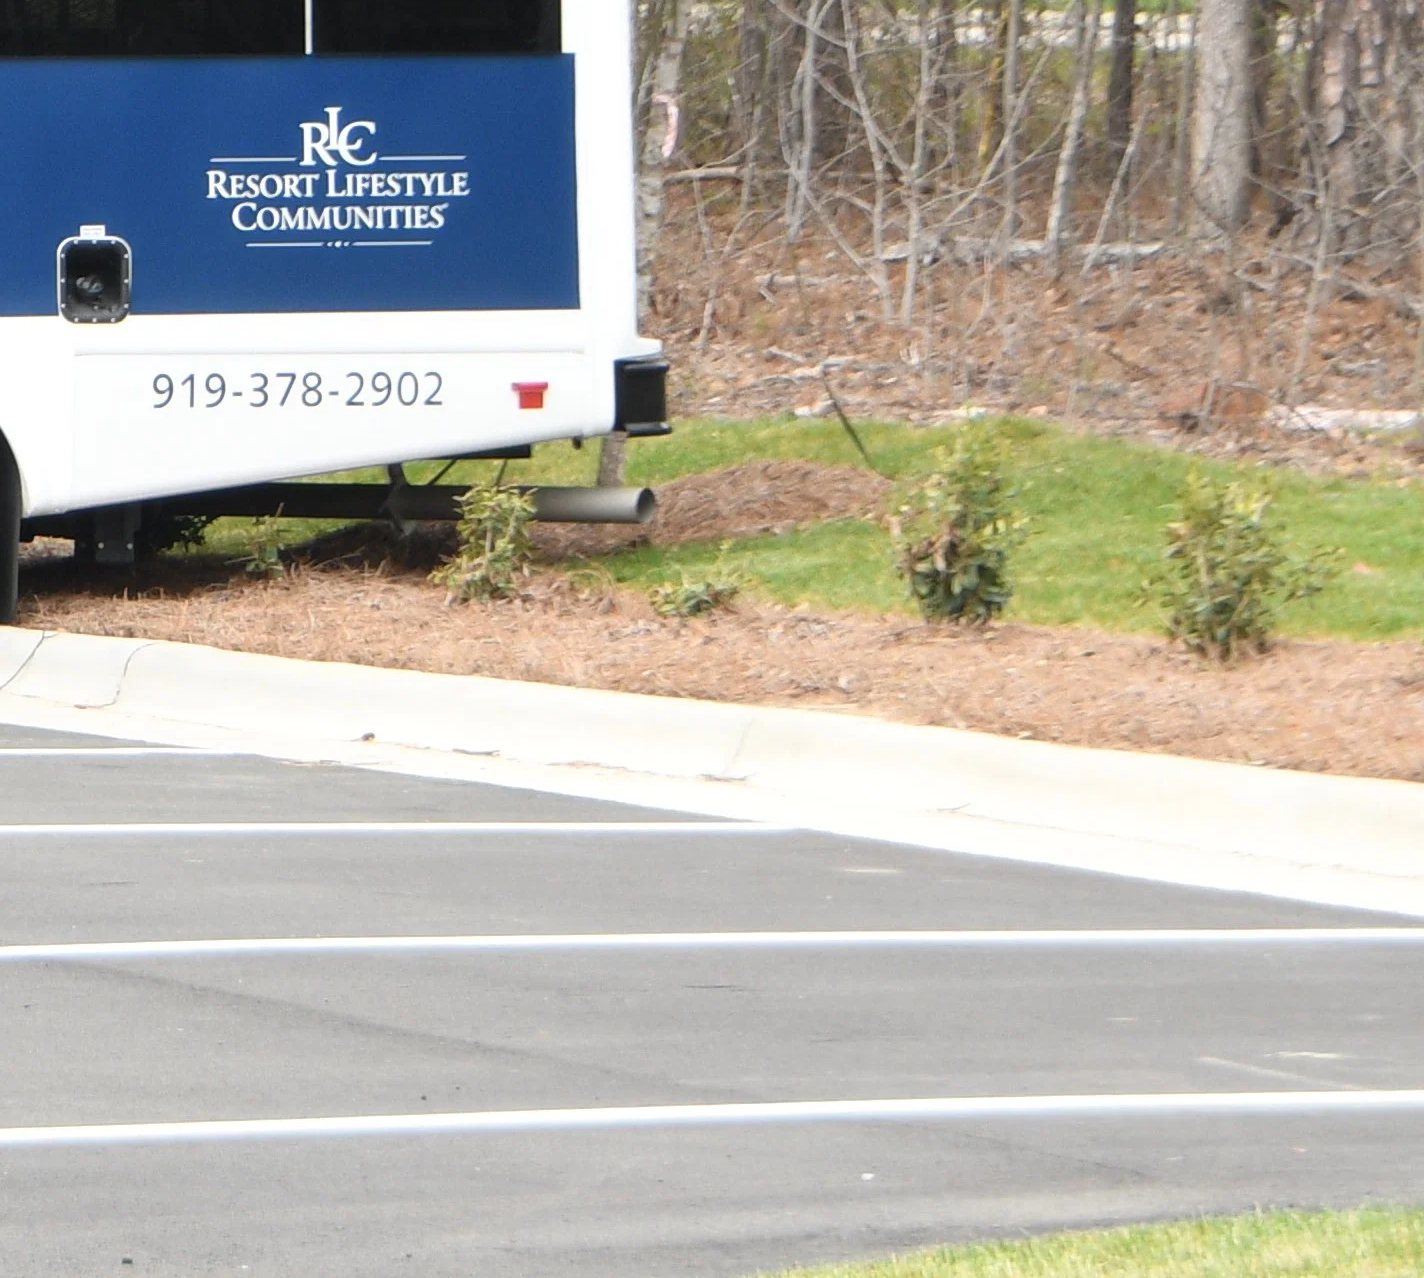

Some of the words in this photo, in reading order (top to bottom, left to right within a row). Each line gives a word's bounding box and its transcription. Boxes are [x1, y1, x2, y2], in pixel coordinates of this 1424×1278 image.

[206, 170, 321, 199] RESORT
[325, 168, 471, 198] LIFESTYLE
[232, 202, 450, 232] COMMUNITIES
[152, 372, 445, 409] 919-378-2902
